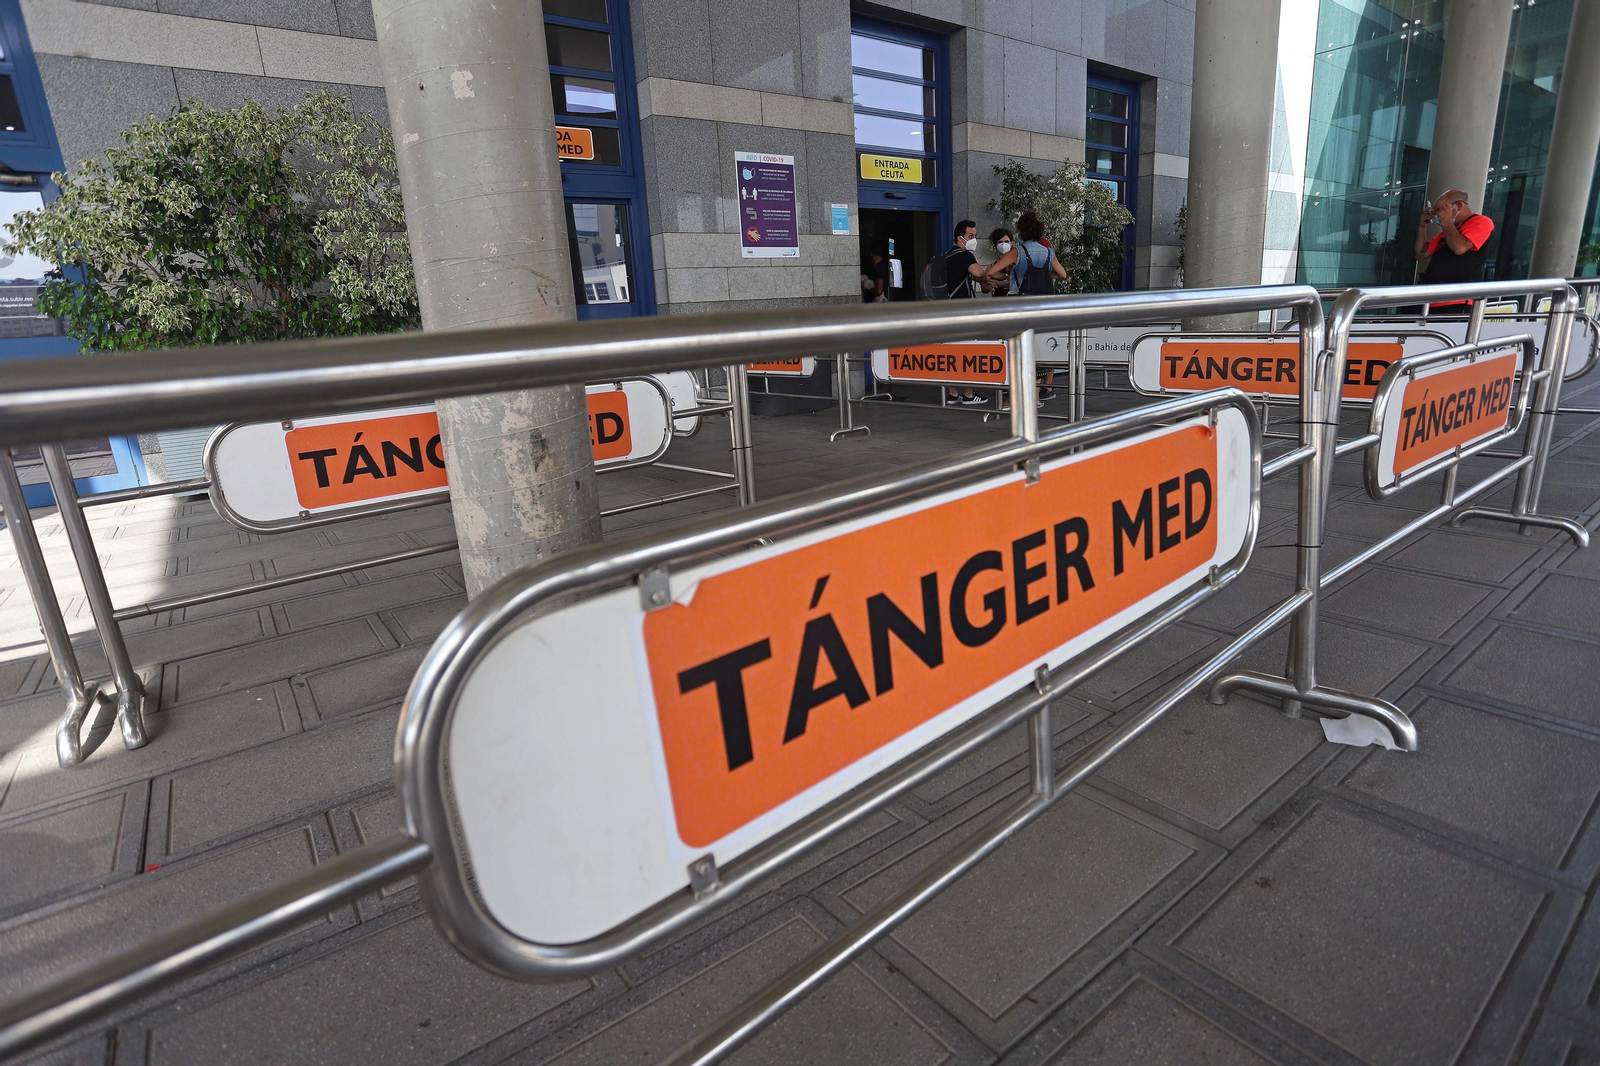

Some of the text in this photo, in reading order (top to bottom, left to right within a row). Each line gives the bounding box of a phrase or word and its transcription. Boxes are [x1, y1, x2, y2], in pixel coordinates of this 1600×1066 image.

[763, 155, 784, 163] COVID-19
[874, 159, 909, 170] ENTRADA
[880, 169, 905, 179] CEUTA
[1094, 342, 1118, 351] Bahía
[890, 348, 1004, 374] TÁNGER MED
[1164, 348, 1392, 386] TÁNGER ED
[1402, 376, 1511, 451] TÁNGER MED
[678, 467, 1212, 772] TÁNGER MED
